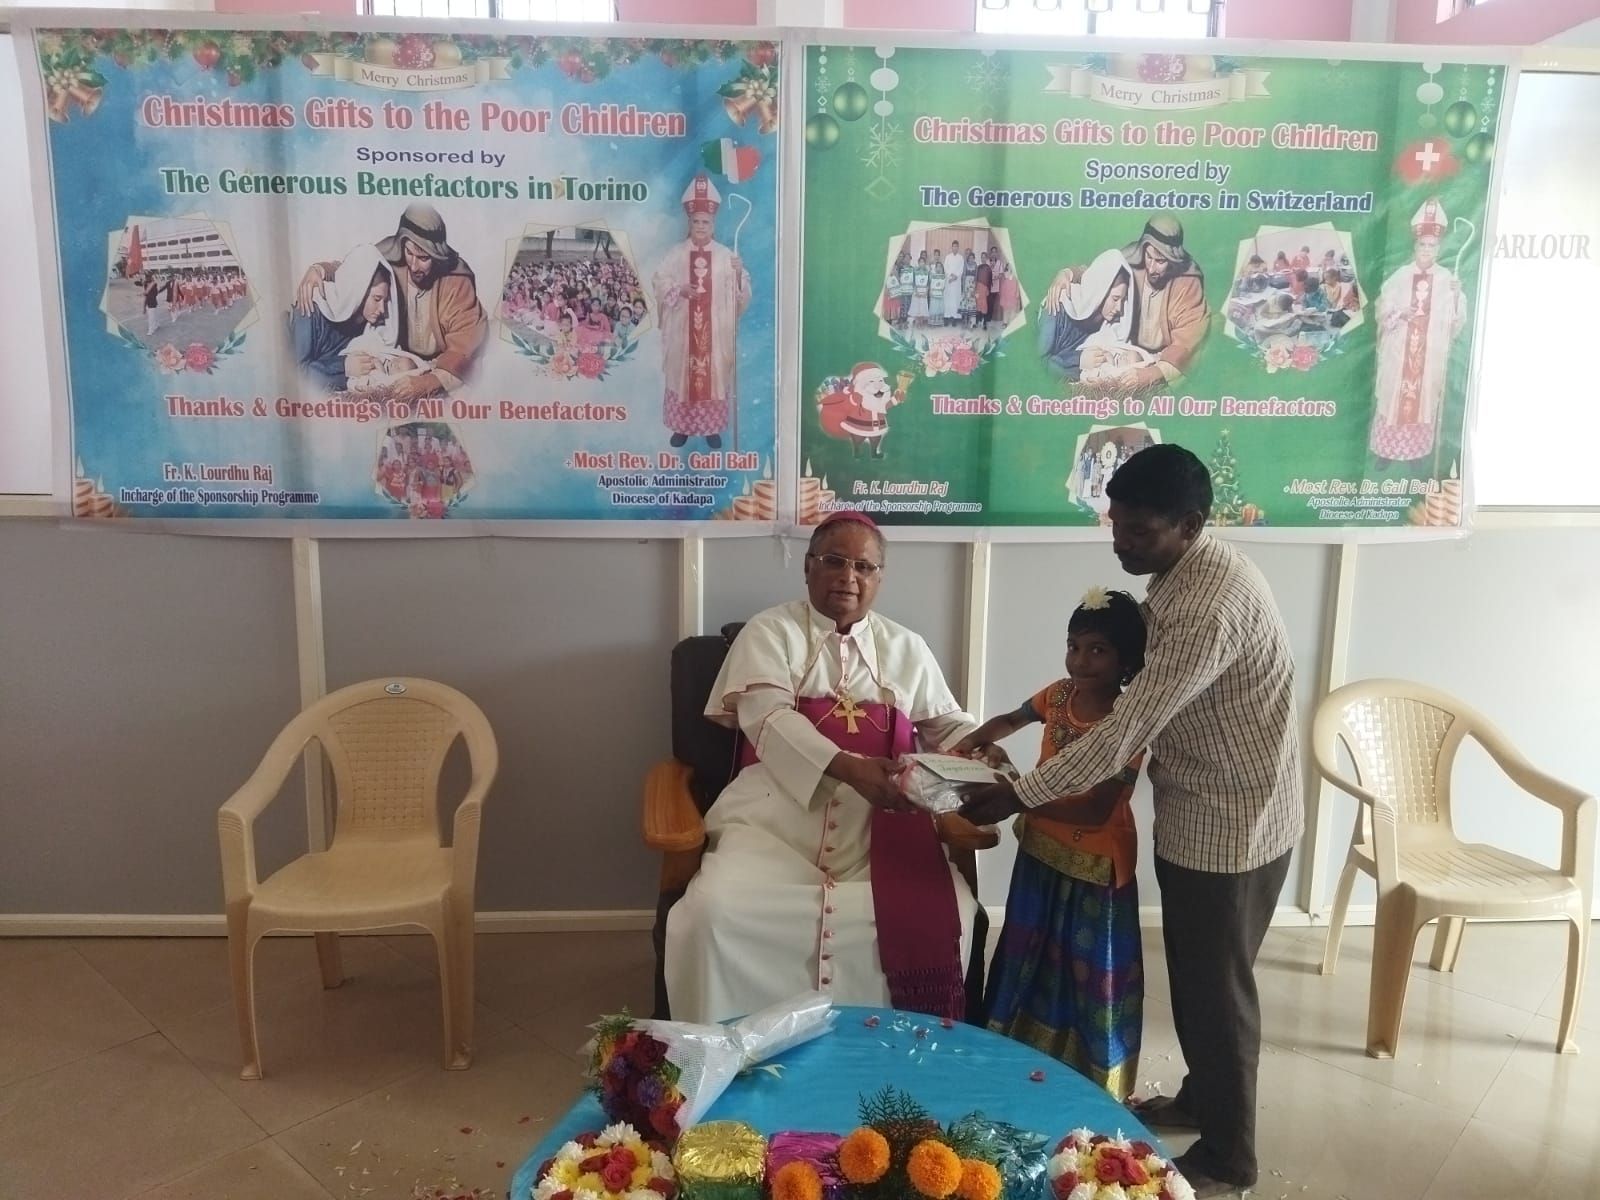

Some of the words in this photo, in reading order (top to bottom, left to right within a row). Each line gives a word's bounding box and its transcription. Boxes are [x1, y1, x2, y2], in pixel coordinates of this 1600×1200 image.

[361, 68, 399, 87] Merry
[407, 73, 468, 86] Christmas
[1101, 83, 1142, 105] Merry
[1152, 88, 1221, 104] Christmas
[143, 96, 295, 127] Christmas
[305, 97, 374, 129] Gifts
[383, 101, 414, 130] to
[423, 100, 471, 132] the
[481, 102, 551, 133] Poor
[561, 104, 686, 136] Children
[915, 117, 1046, 144] Christmas
[1055, 119, 1113, 145] Gifts
[1121, 121, 1147, 146] to
[1156, 120, 1196, 146] the
[1204, 122, 1264, 148] Poor
[1273, 123, 1378, 151] Children
[357, 147, 474, 165] Sponsored
[481, 151, 506, 167] by
[1086, 159, 1199, 182] Sponsored
[1205, 161, 1230, 184] by
[161, 168, 210, 194] The
[219, 169, 348, 196] Generous
[357, 171, 518, 199] Benefactors
[528, 176, 553, 200] in
[561, 177, 648, 201] Torino
[921, 186, 961, 207] The
[968, 187, 1072, 209] Generous
[1080, 188, 1211, 210] Benefactors
[1219, 190, 1239, 210] in
[1247, 191, 1373, 212] Switzerland
[1490, 233, 1591, 259] ARLOUR
[165, 396, 244, 417] Thanks
[252, 397, 267, 417] &
[275, 397, 380, 422] Greetings
[387, 400, 409, 419] to
[417, 398, 443, 419] All
[452, 400, 491, 419] Our
[500, 400, 627, 420] Benefactors
[931, 395, 1000, 414] Thanks
[1006, 395, 1021, 415] &
[1027, 395, 1119, 419] Greetings
[1124, 397, 1144, 415] to
[1149, 396, 1174, 416] All
[1179, 397, 1216, 416] Our
[1221, 396, 1336, 416] Benefactors
[619, 453, 653, 469] Rev.
[659, 453, 684, 469] Dr.
[689, 452, 721, 469] Gali
[727, 452, 758, 470] Bali
[164, 464, 181, 480] Fr.
[184, 464, 197, 480] K.
[200, 465, 249, 481] Lourdhu
[253, 465, 273, 484] Raj
[598, 475, 649, 488] Apostolic
[652, 475, 728, 487] Administrator
[853, 480, 868, 494] Fr.
[870, 481, 882, 494] K.
[883, 481, 928, 495] Lourdhu
[929, 481, 949, 497] Raj
[1328, 479, 1358, 494] Rev.
[1359, 480, 1379, 494] Dr.
[1381, 480, 1408, 494] Gali
[121, 488, 164, 505] Incharge
[166, 489, 177, 502] of
[179, 489, 195, 502] the
[198, 489, 259, 506] Sponsorship
[261, 490, 320, 506] Programme
[612, 493, 655, 504] Diocese
[658, 493, 670, 504] of
[672, 493, 713, 506] Kadapa
[856, 500, 867, 512] of
[867, 500, 880, 512] the
[881, 500, 931, 514] Sponsorship
[933, 501, 982, 514] Programme
[1307, 496, 1351, 509] Apostolic
[1351, 496, 1412, 507] Administrator
[1319, 509, 1354, 520] Diocese
[1354, 509, 1366, 520] of
[1365, 509, 1400, 521] Kadapa
